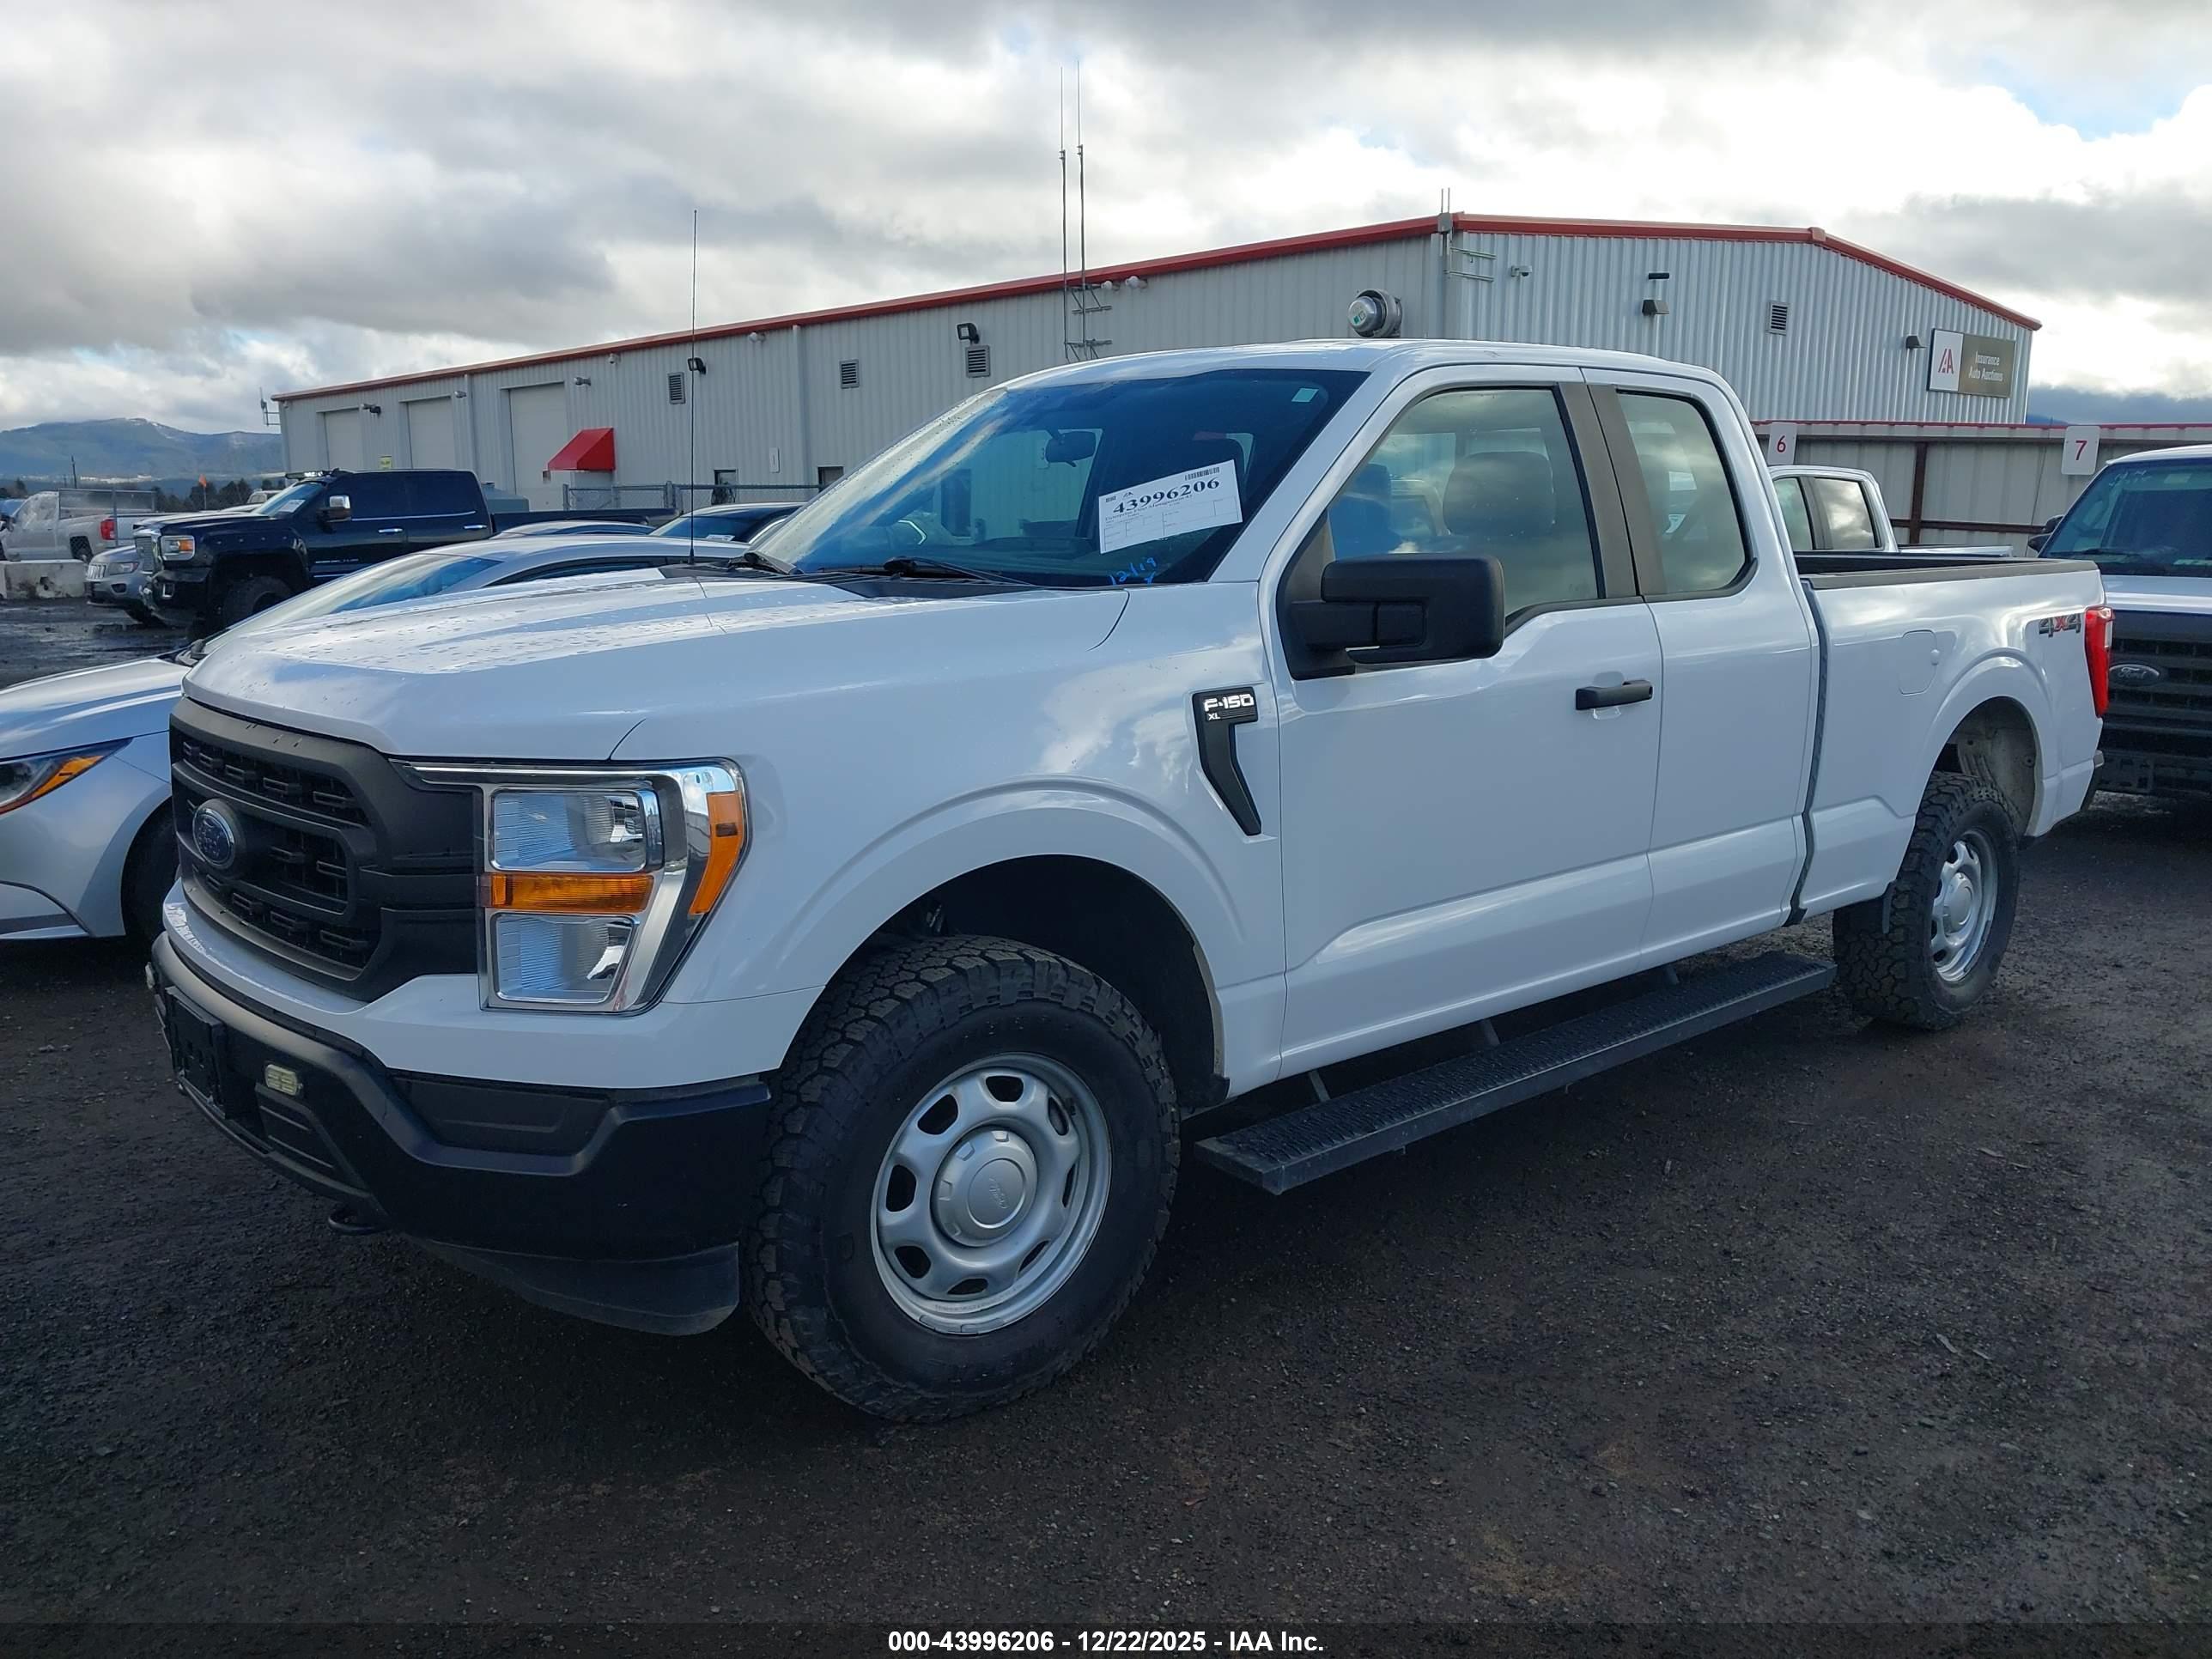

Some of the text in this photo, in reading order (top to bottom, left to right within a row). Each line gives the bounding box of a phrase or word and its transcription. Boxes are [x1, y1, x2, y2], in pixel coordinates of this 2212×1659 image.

[1777, 434, 1786, 453] 6
[2075, 440, 2087, 461] 7
[1113, 478, 1220, 514] 43996206
[2118, 665, 2148, 680] Ford
[1204, 693, 1255, 712] F-150
[1208, 712, 1220, 720] XL
